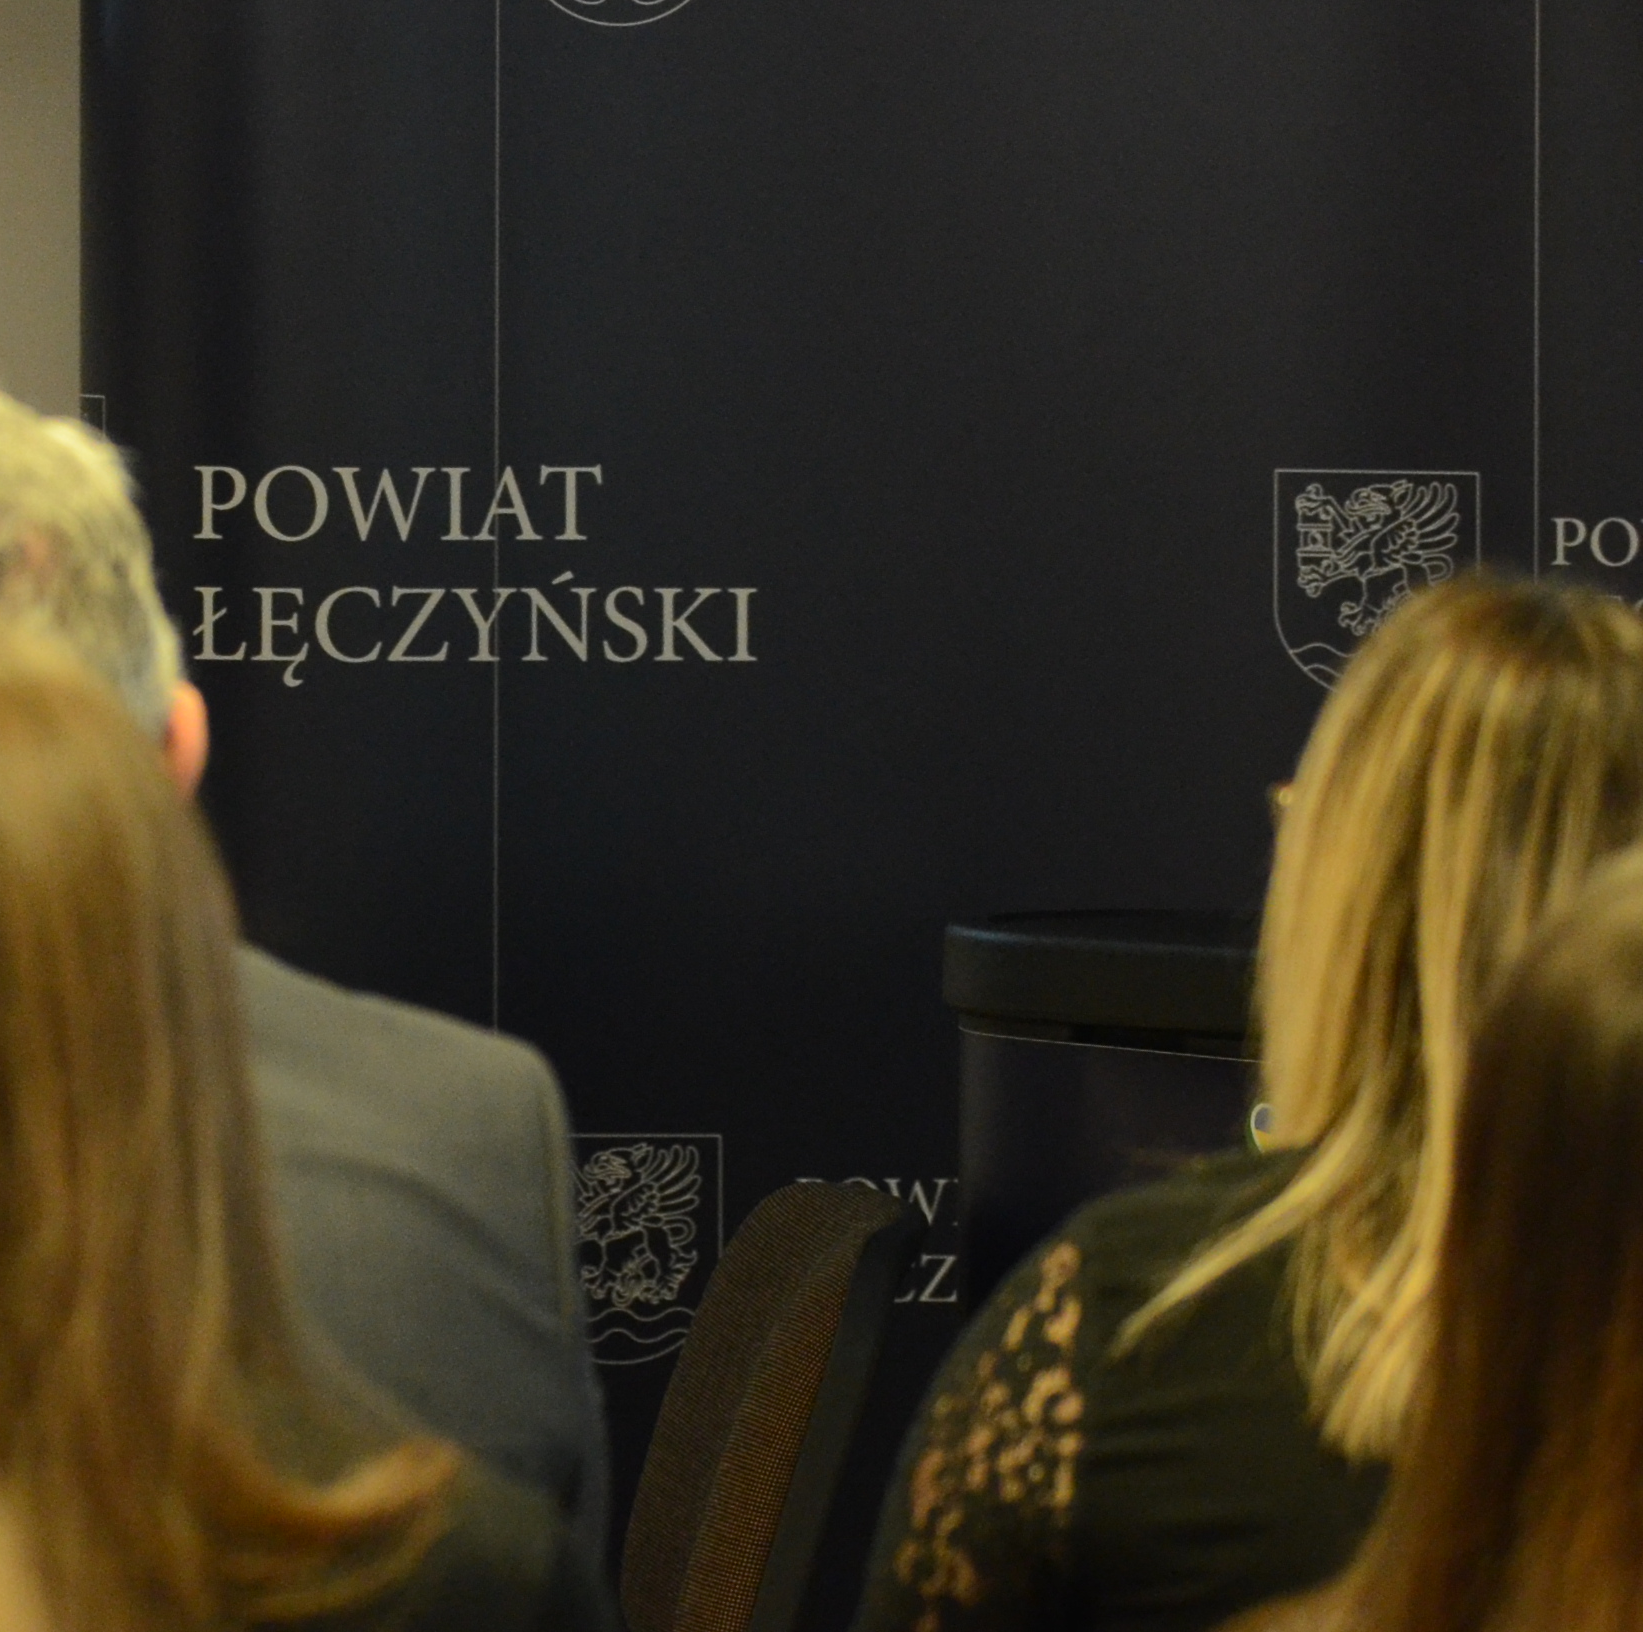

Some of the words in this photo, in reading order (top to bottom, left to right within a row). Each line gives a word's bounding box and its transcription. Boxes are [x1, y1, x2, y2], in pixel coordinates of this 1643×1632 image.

[194, 464, 603, 542] POWIAT
[1551, 517, 1643, 567] PO
[193, 570, 757, 689] ŁĘCZYŃSKI
